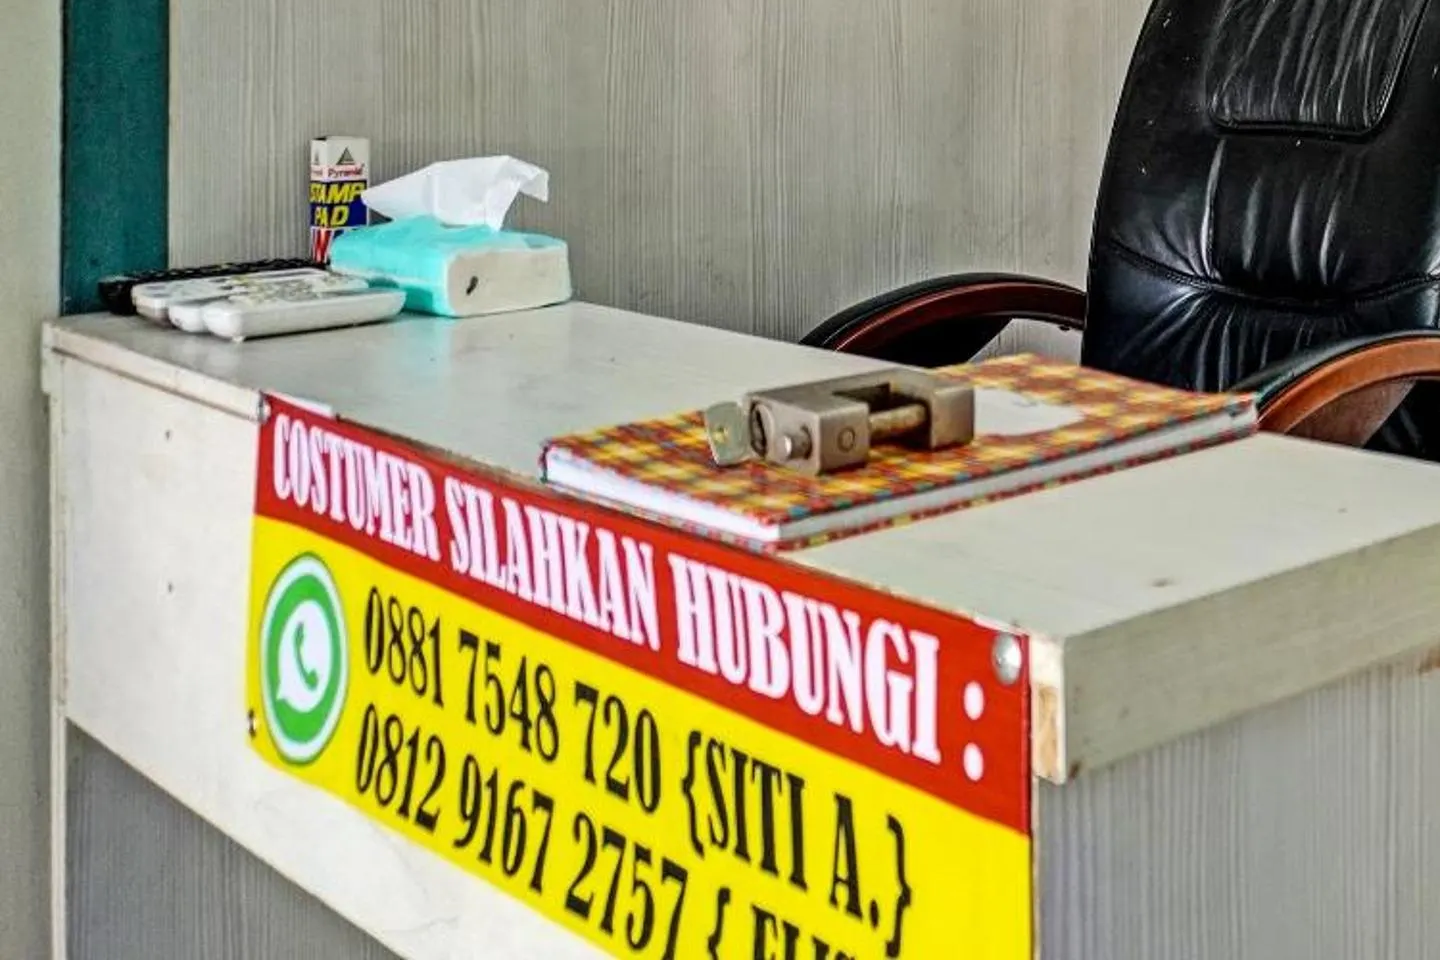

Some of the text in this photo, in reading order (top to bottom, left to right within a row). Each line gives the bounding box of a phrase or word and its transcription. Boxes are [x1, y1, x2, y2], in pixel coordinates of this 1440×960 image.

[314, 205, 350, 227] PAD
[272, 413, 441, 562] COSTUMER
[443, 475, 661, 653] SILAHKAN
[667, 552, 942, 765] HUBUNGI
[355, 702, 447, 836] 0812
[452, 754, 555, 896] 9167
[564, 811, 689, 960] 2757
[364, 586, 444, 708] 0881
[458, 628, 560, 763] 7548
[573, 680, 662, 814] 720
[681, 729, 809, 894] {SITI
